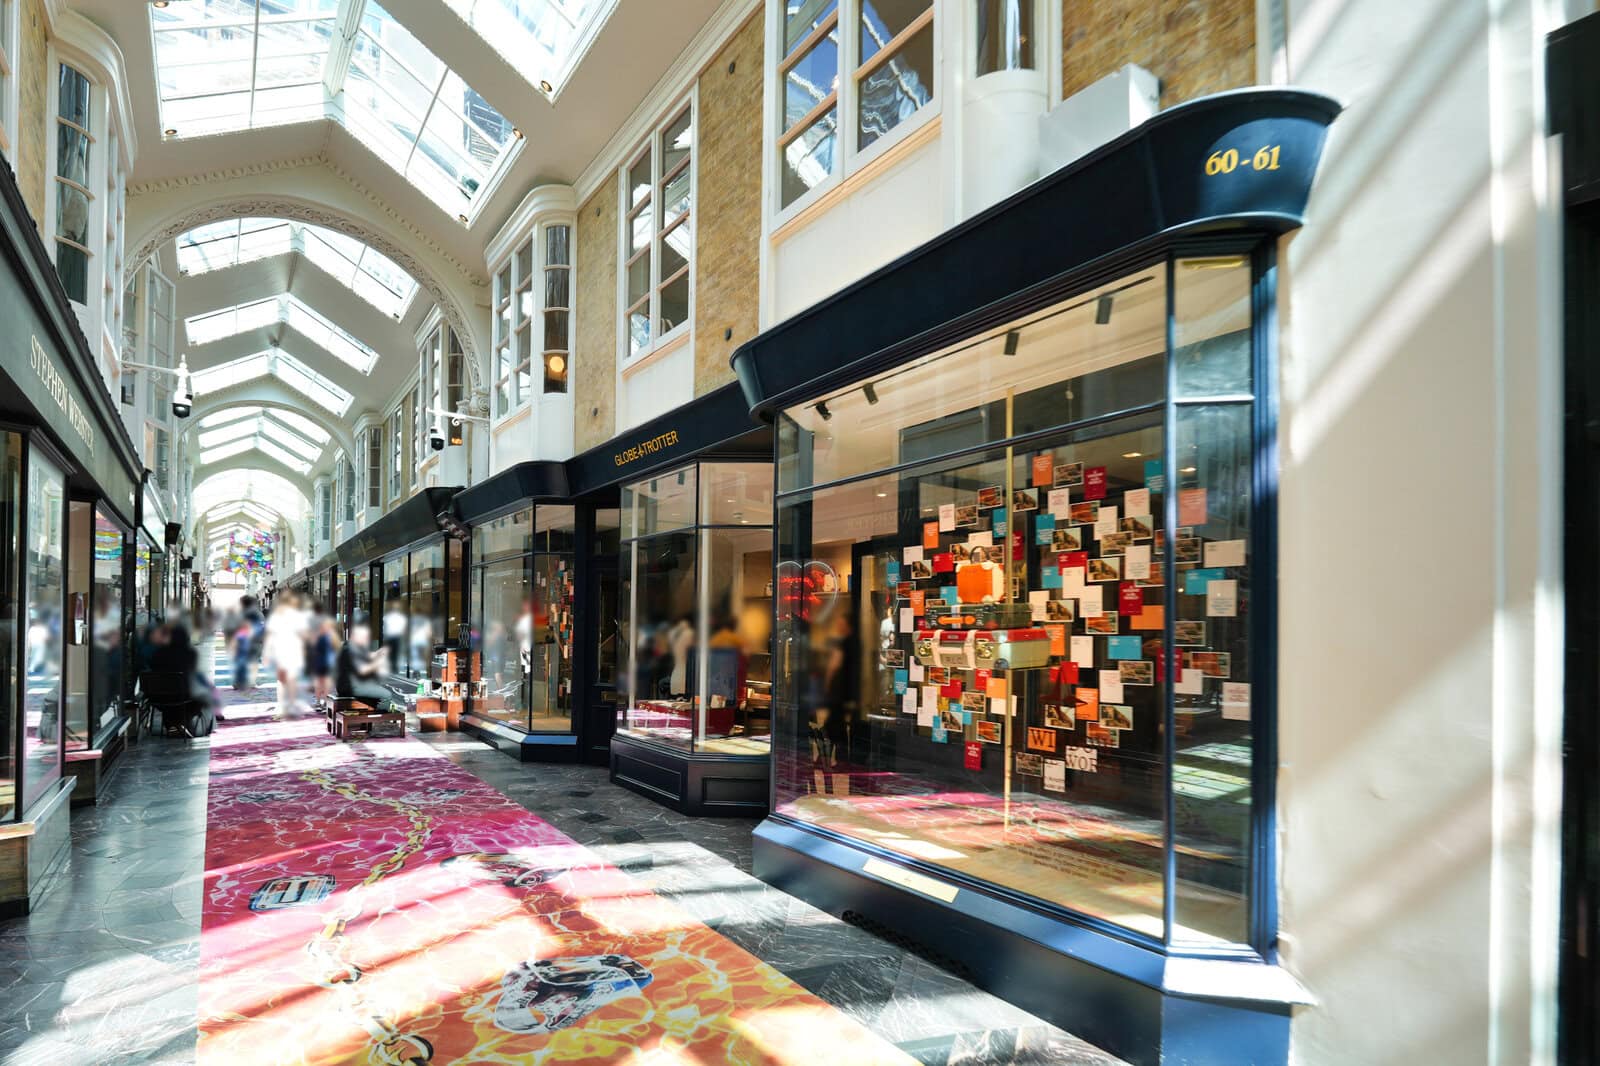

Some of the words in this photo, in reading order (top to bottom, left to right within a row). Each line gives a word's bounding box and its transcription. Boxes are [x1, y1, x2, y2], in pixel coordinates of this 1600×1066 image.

[1204, 144, 1281, 176] 60-61
[30, 334, 68, 415] STEPHEN
[68, 391, 95, 457] WEBSTER
